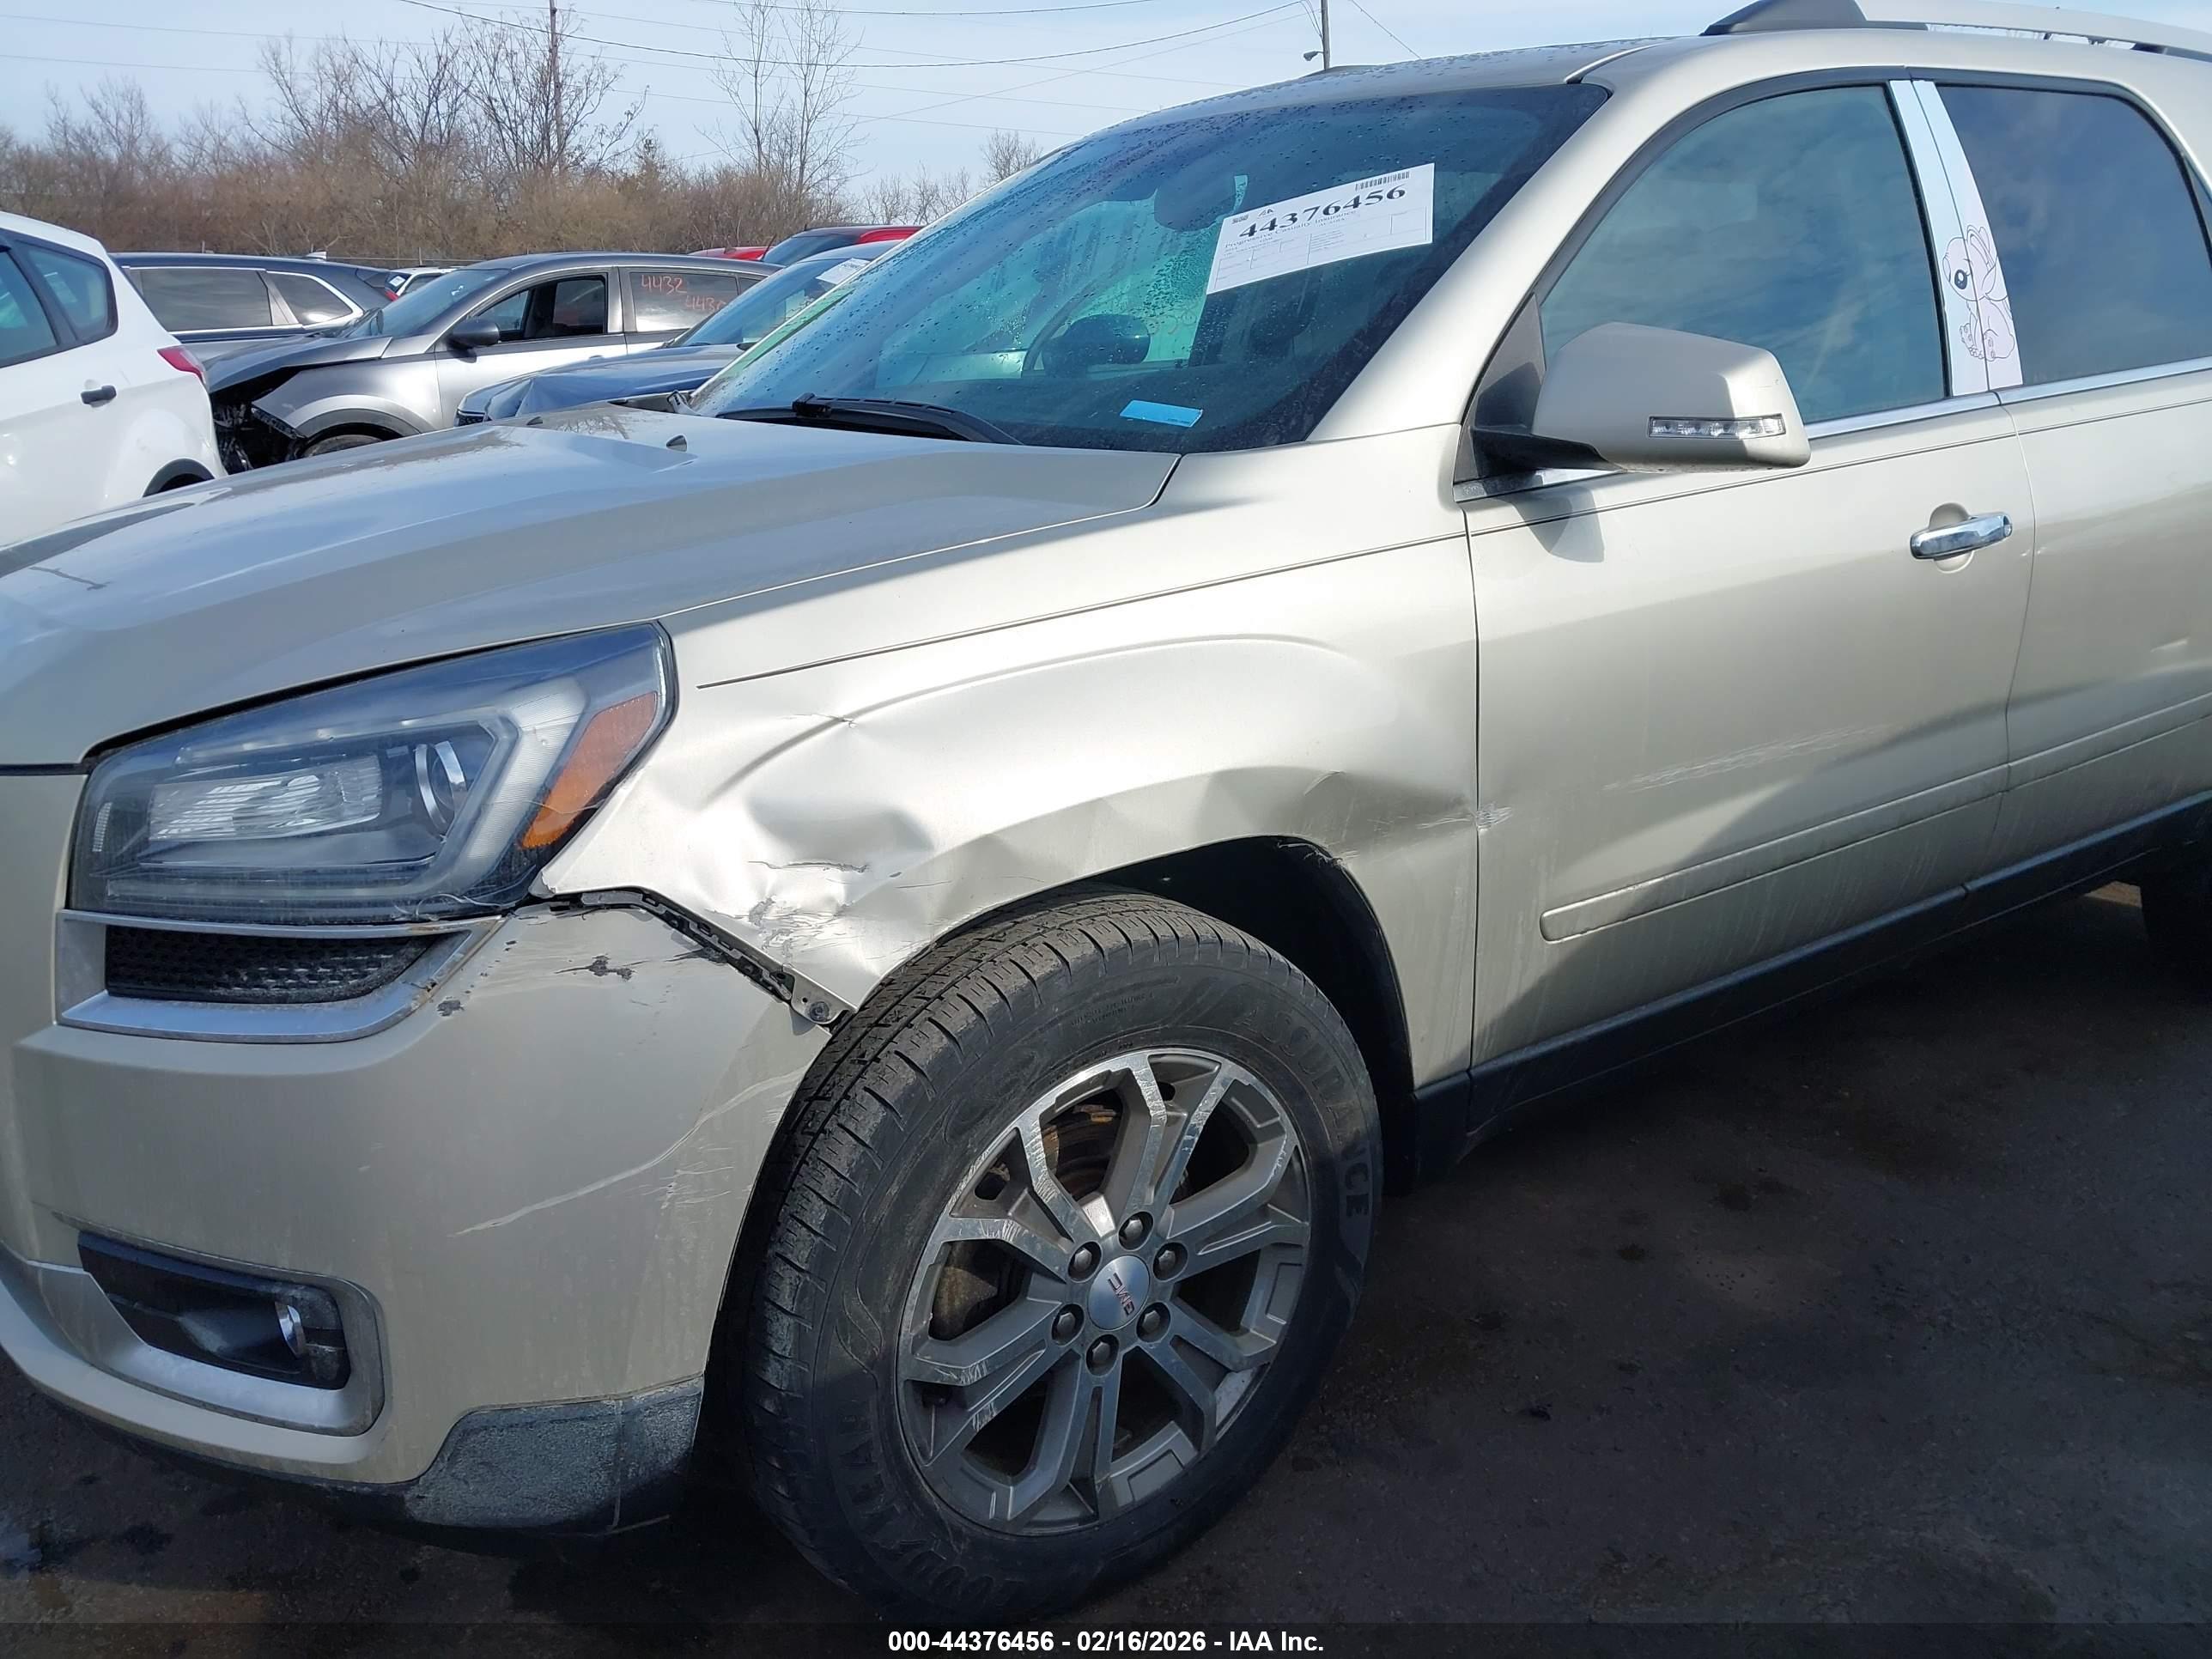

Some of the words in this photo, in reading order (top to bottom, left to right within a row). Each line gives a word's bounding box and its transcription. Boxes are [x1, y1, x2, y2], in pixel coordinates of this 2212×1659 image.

[1238, 184, 1407, 238] 44376456
[1224, 232, 1273, 249] Progressive
[1275, 220, 1311, 234] Casualty
[641, 274, 687, 295] 4432
[1107, 1272, 1135, 1316] GMC
